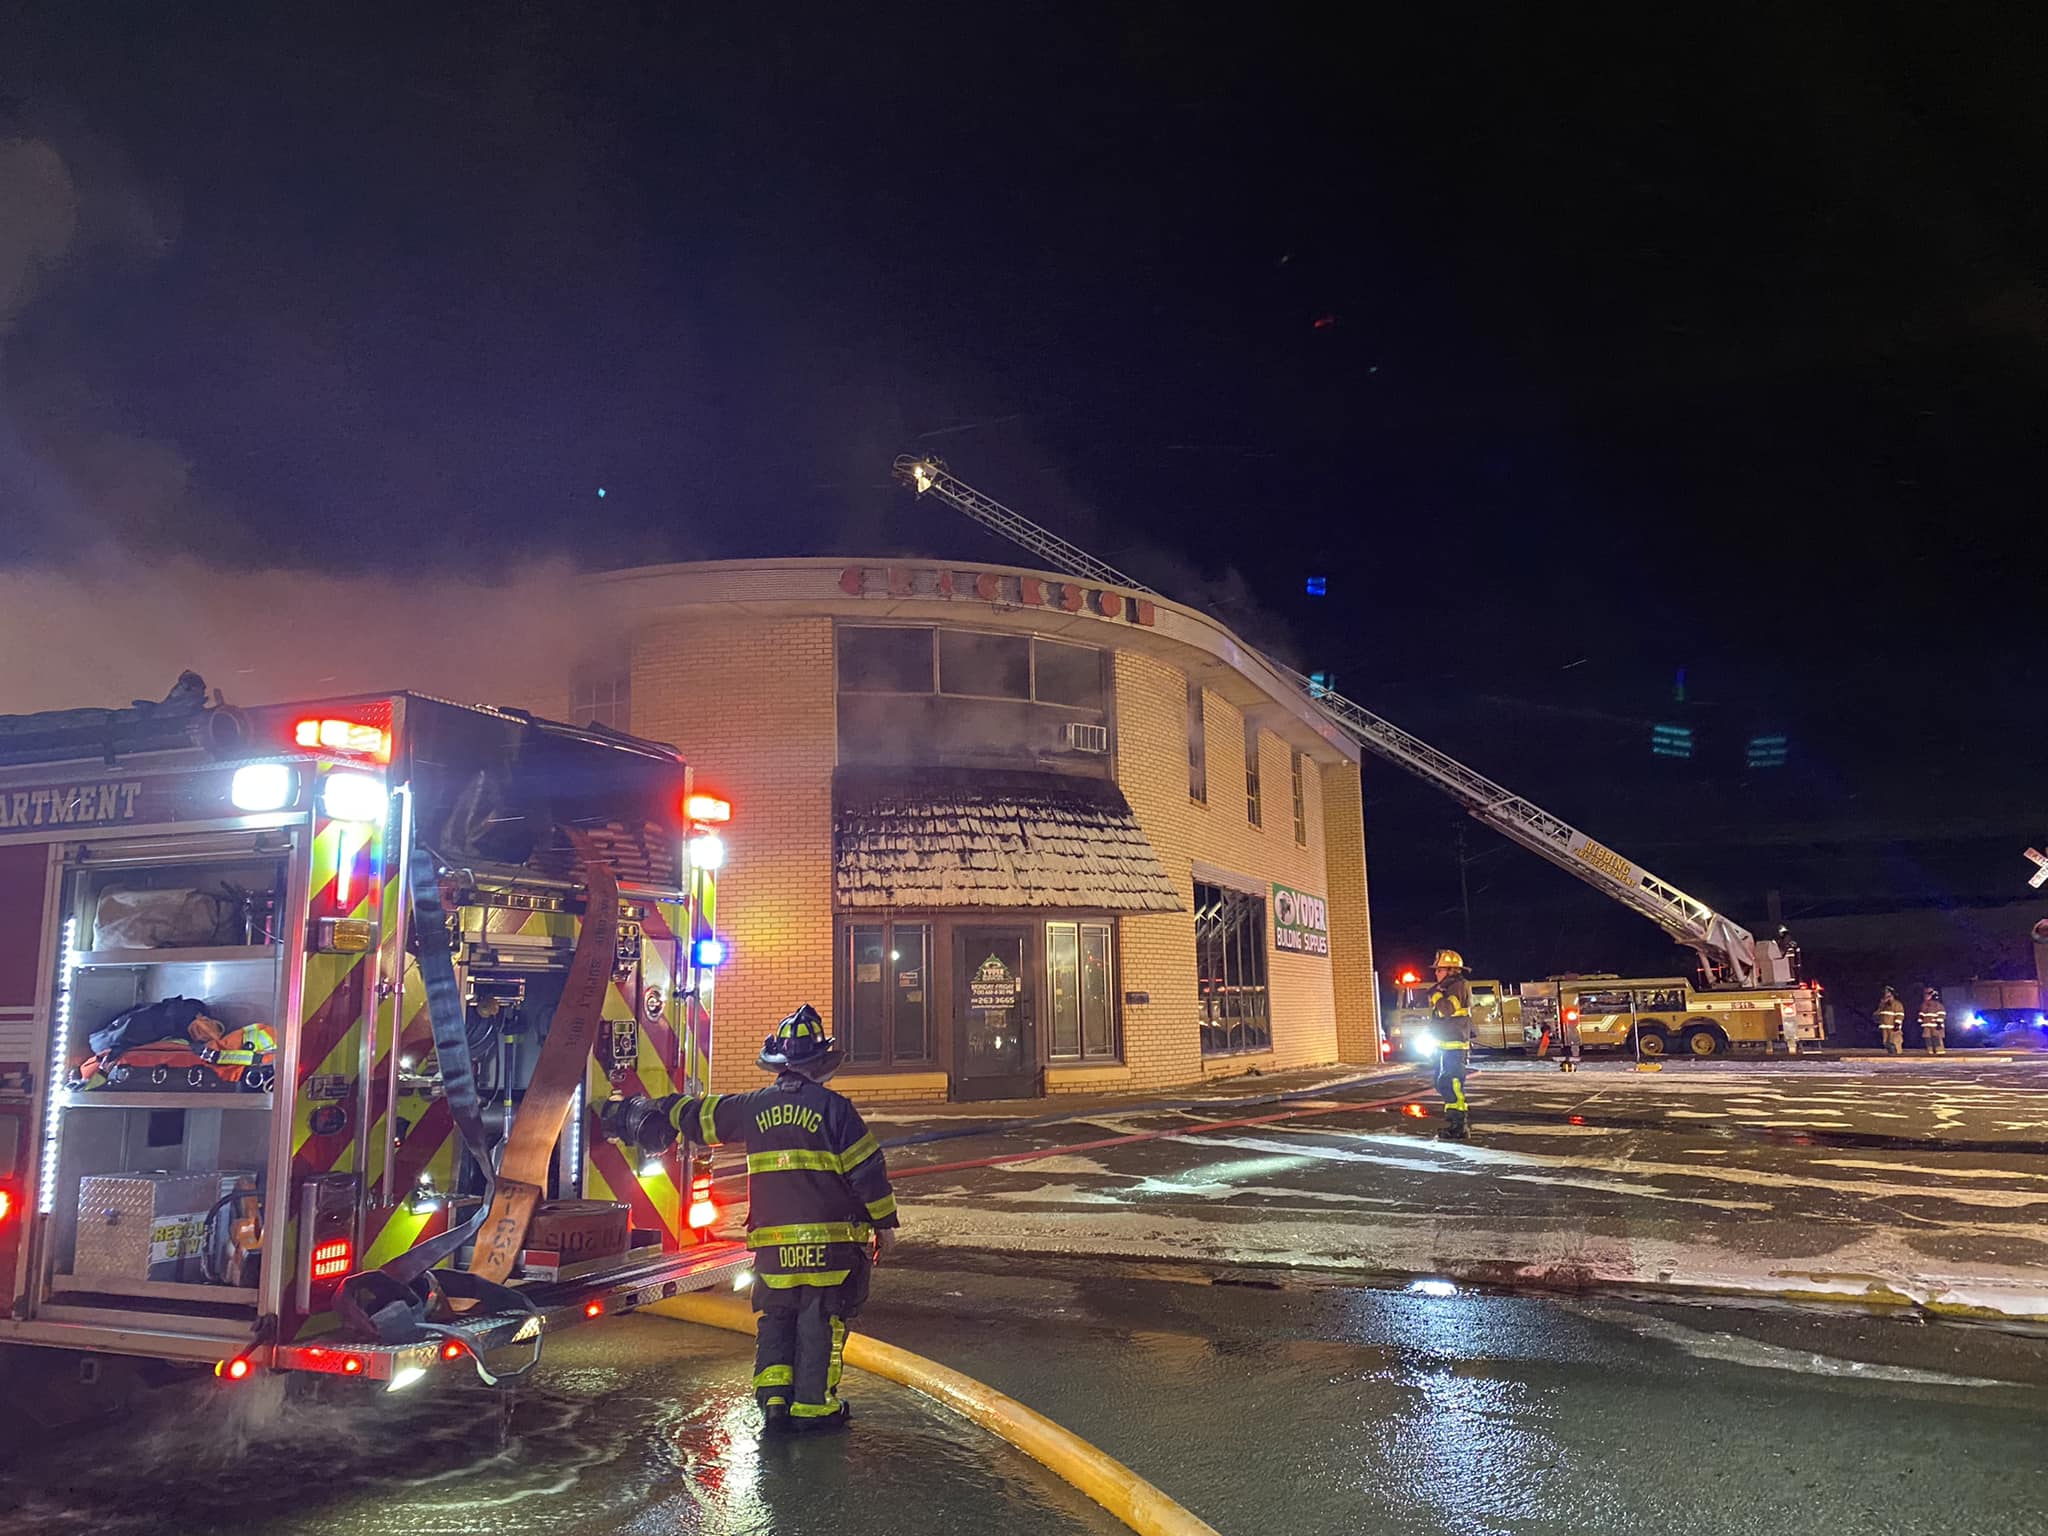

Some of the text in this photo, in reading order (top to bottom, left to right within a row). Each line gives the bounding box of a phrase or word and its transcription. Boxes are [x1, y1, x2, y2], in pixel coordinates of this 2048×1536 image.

[1585, 840, 1631, 875] HIBBING
[1591, 857, 1637, 888] DEPARTMENT
[1292, 891, 1327, 931] YODER
[1277, 927, 1301, 949] BUILDING
[756, 1104, 823, 1133] HIBBING
